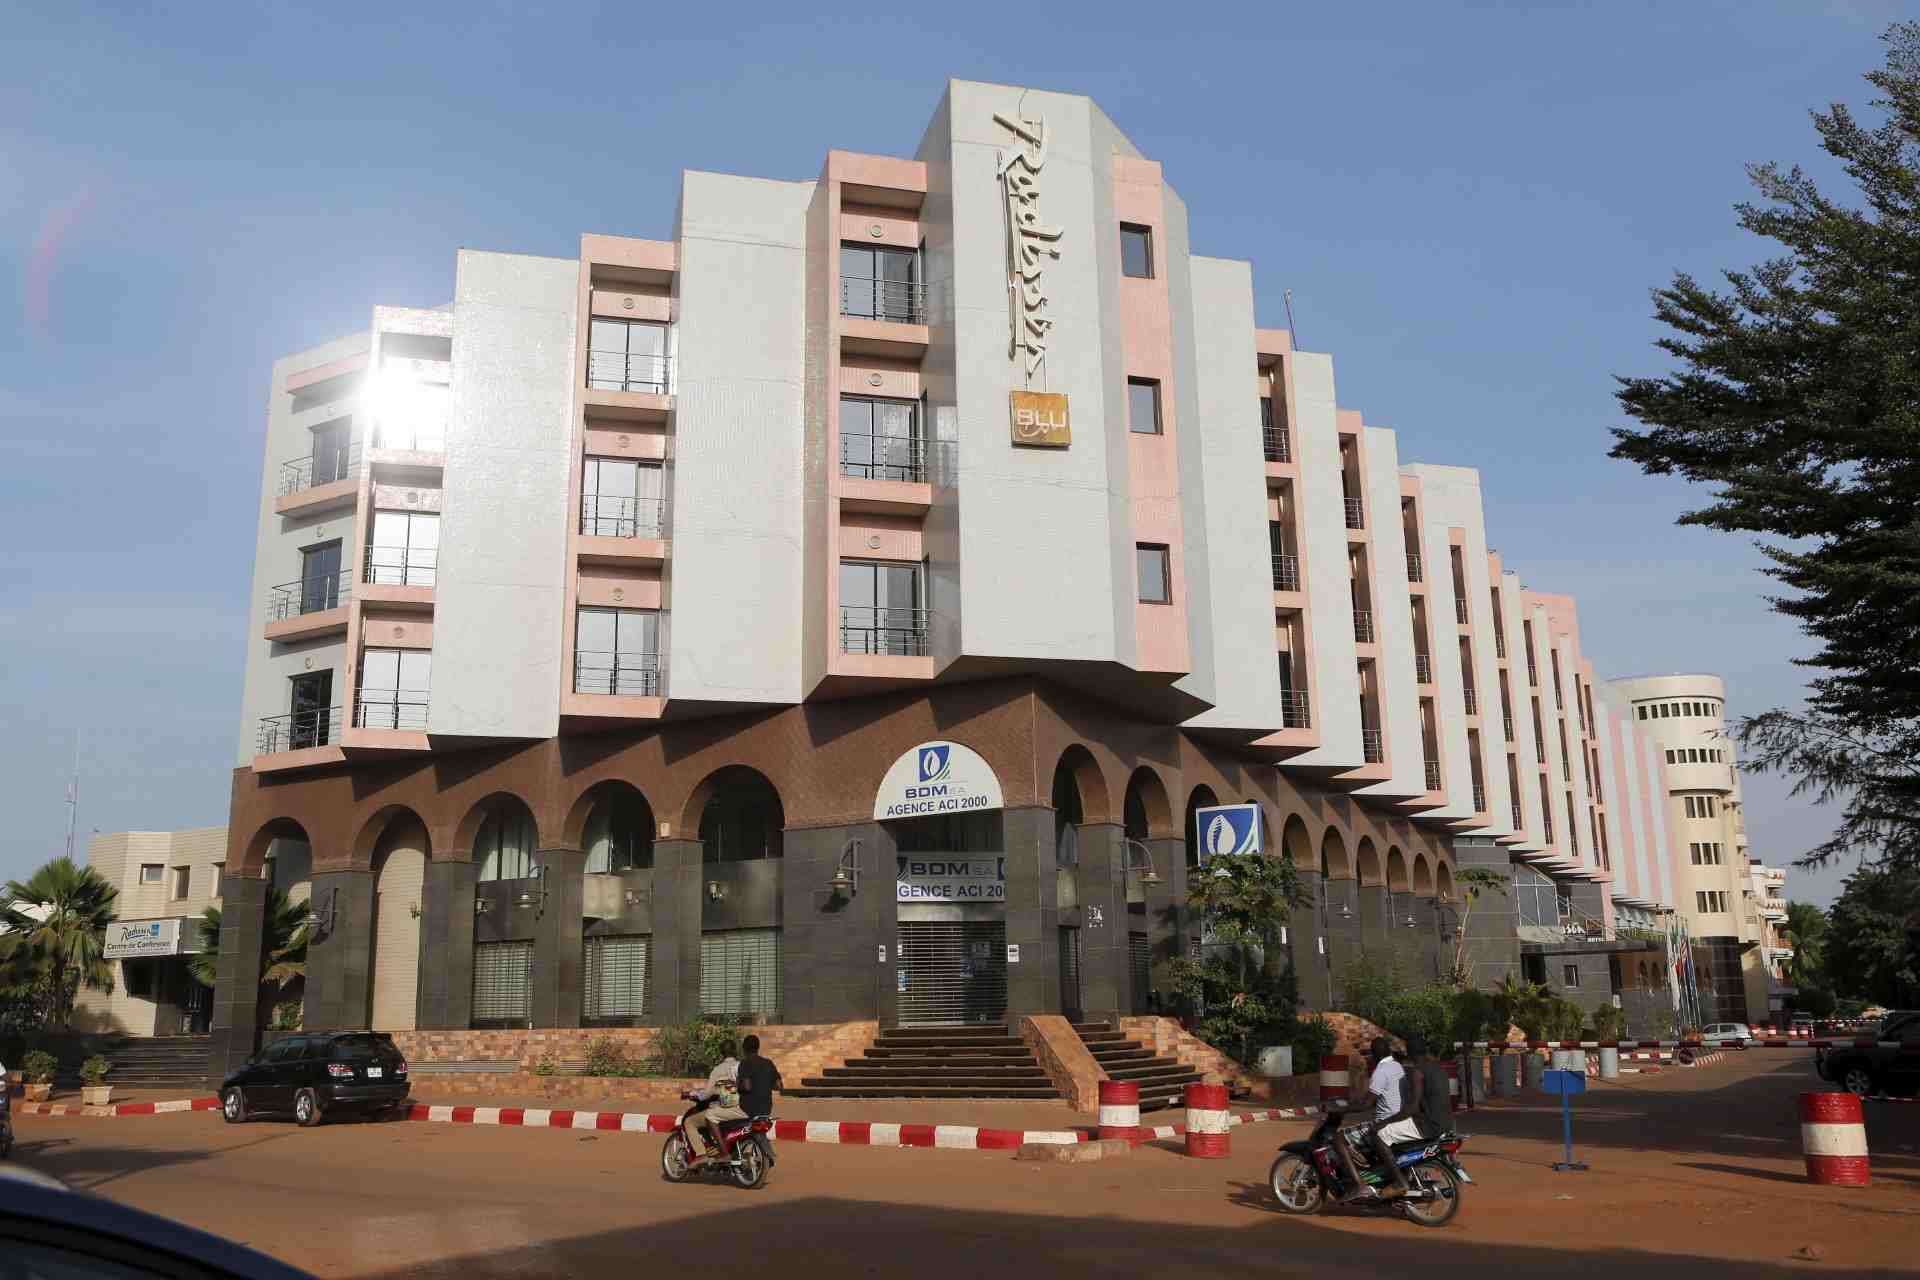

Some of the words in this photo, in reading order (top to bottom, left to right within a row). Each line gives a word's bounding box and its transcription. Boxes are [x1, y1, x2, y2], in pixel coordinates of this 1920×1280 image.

[905, 785, 948, 799] BDM
[887, 801, 935, 817] AGENCE
[938, 799, 958, 811] ACI
[961, 795, 988, 808] 2000
[911, 862, 969, 876] BDM
[898, 885, 952, 898] GENCE
[957, 885, 983, 897] ACI
[986, 885, 1006, 897] 20
